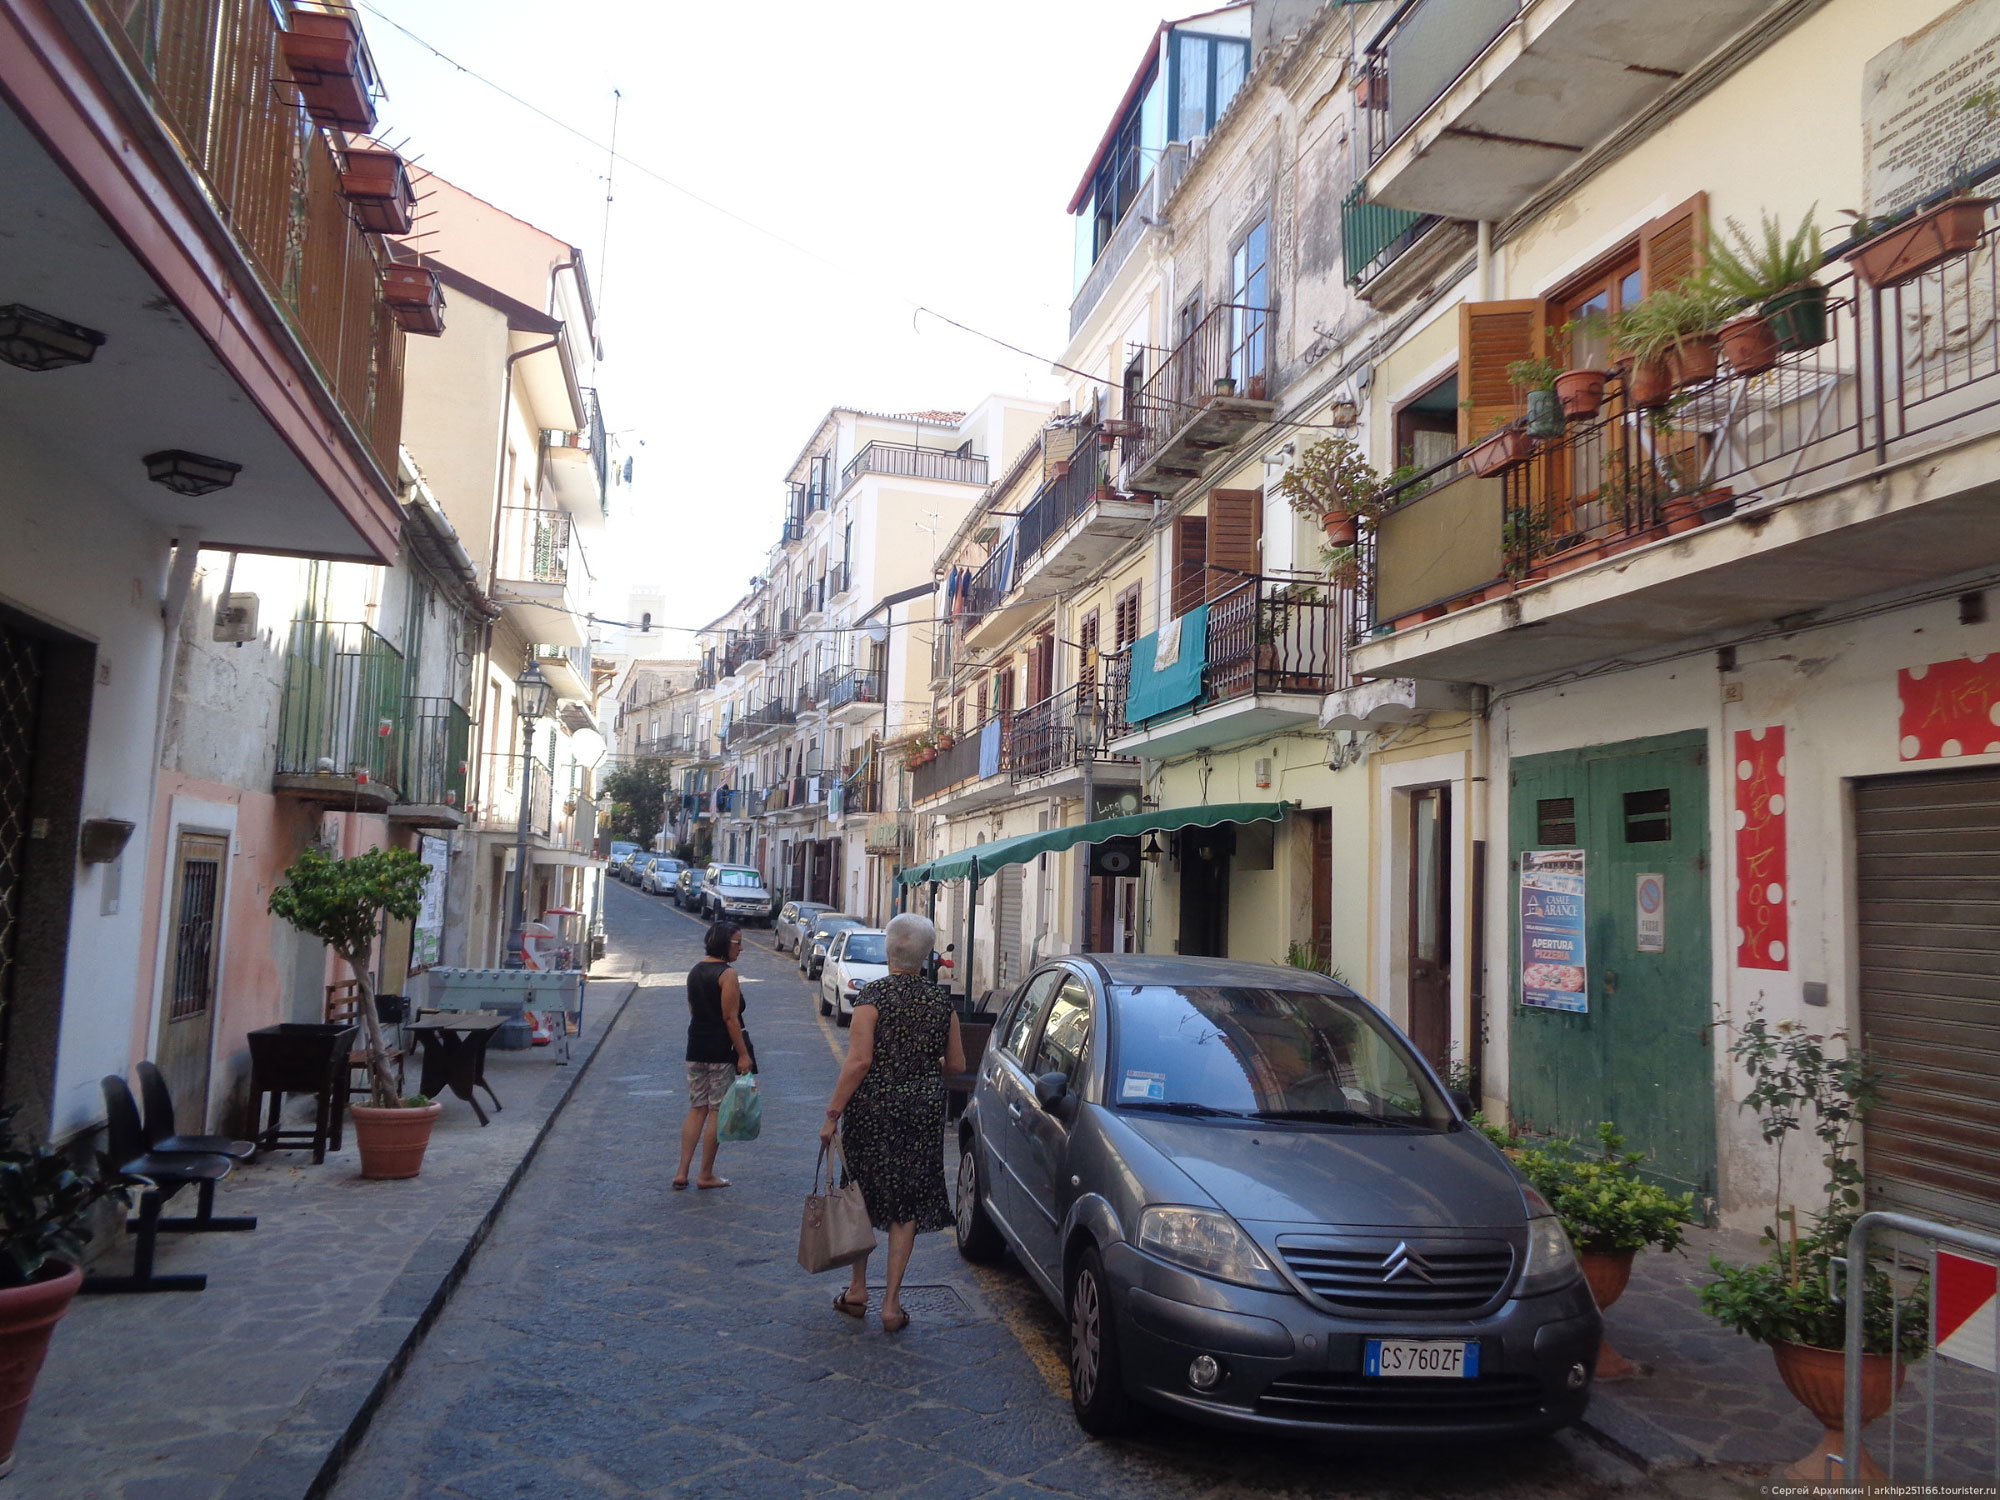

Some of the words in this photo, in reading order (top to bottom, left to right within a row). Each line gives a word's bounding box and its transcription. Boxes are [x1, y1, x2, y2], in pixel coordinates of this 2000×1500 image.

[1949, 55, 1970, 71] CASA
[1888, 95, 1929, 125] GENERALE
[1934, 50, 1996, 95] GIUSEPPE
[1096, 800, 1121, 815] Long
[1546, 895, 1570, 905] CASALE
[1544, 905, 1578, 917] ARANCE
[1532, 938, 1574, 950] APERTURA
[1534, 949, 1571, 961] PIZZERIA
